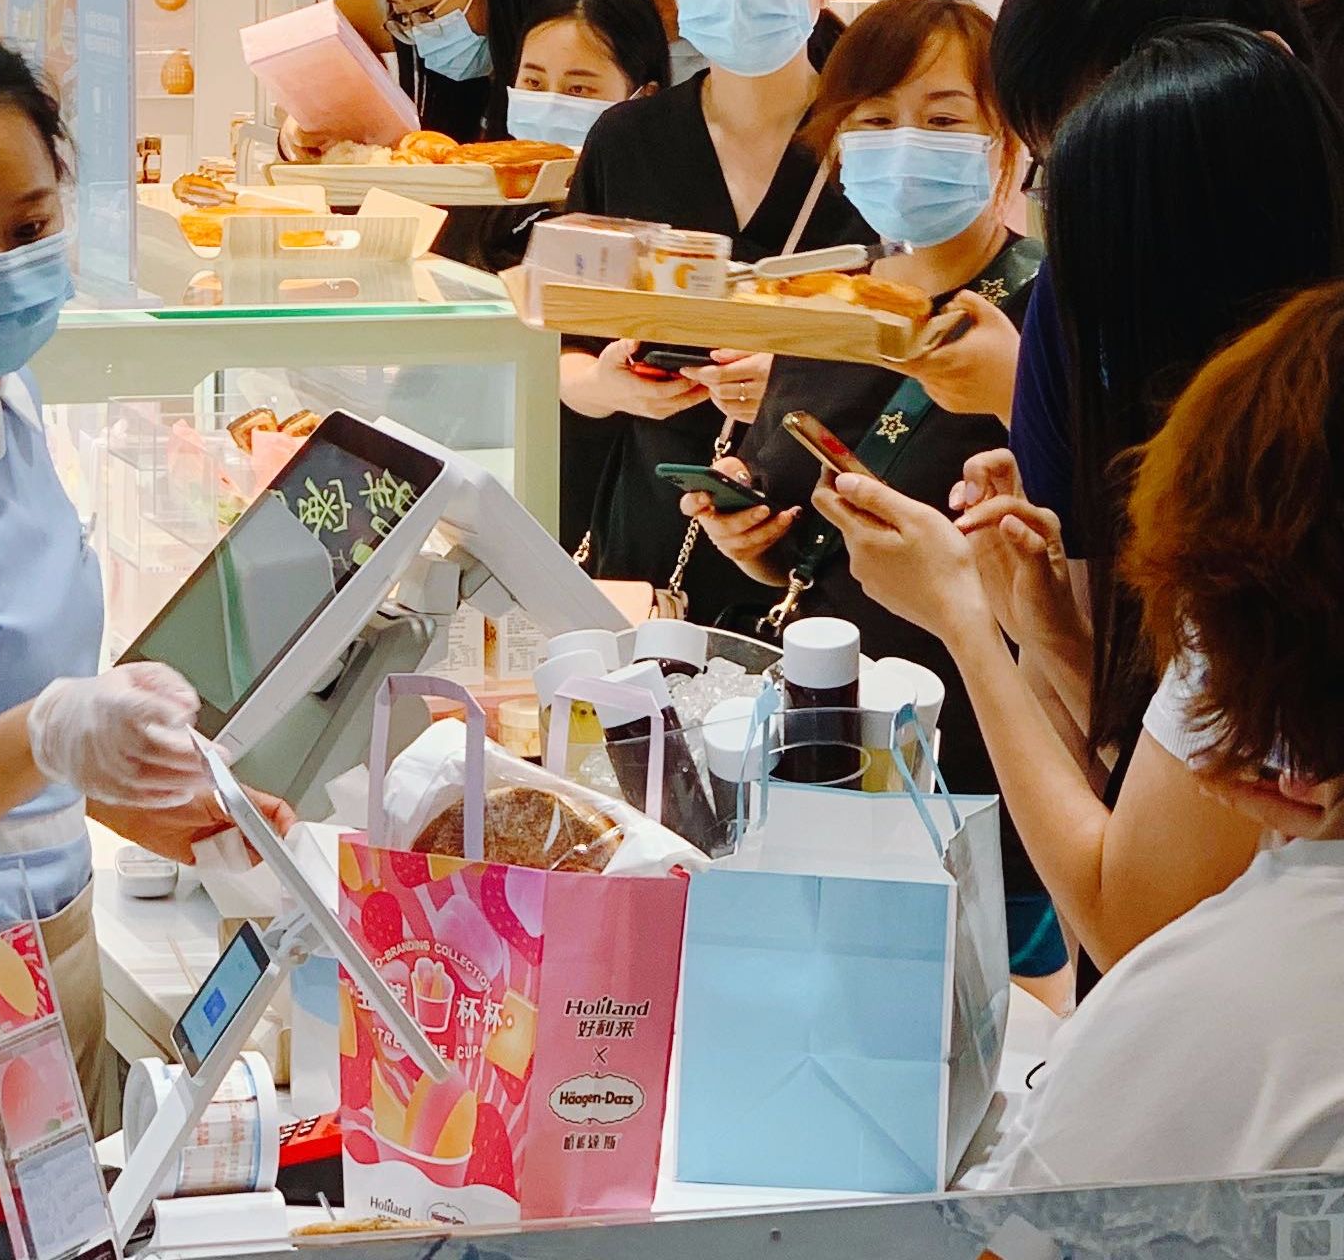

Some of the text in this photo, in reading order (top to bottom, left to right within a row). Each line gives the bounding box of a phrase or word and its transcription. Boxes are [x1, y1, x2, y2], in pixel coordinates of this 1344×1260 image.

[373, 939, 494, 996] O-BRANDING COLLECTION
[456, 994, 505, 1034] 杯杯
[565, 996, 651, 1017] Holiland
[577, 1020, 636, 1038] 好利来
[457, 1047, 480, 1059] CUP
[559, 1091, 634, 1109] Häagen-Dazs
[370, 1196, 412, 1219] Holiland
